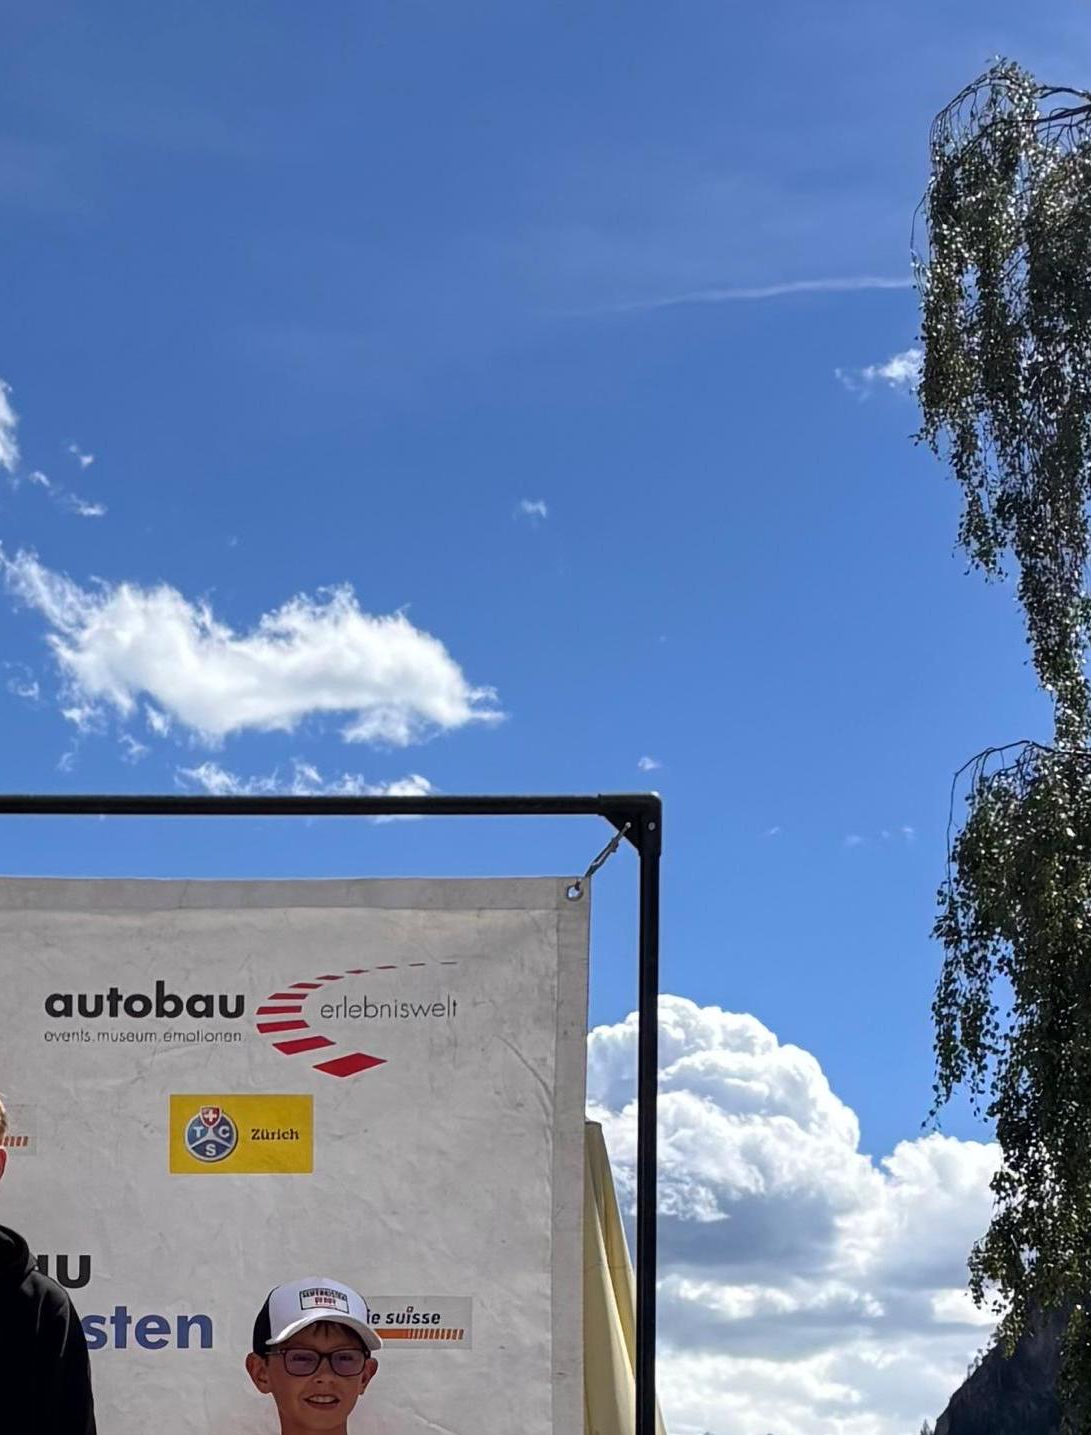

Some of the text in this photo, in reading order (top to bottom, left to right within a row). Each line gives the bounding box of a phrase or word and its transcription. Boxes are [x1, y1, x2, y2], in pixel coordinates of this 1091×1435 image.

[45, 980, 458, 1019] autobau erlebniswelt
[250, 1127, 300, 1141] Zürich
[386, 1305, 441, 1325] suisse
